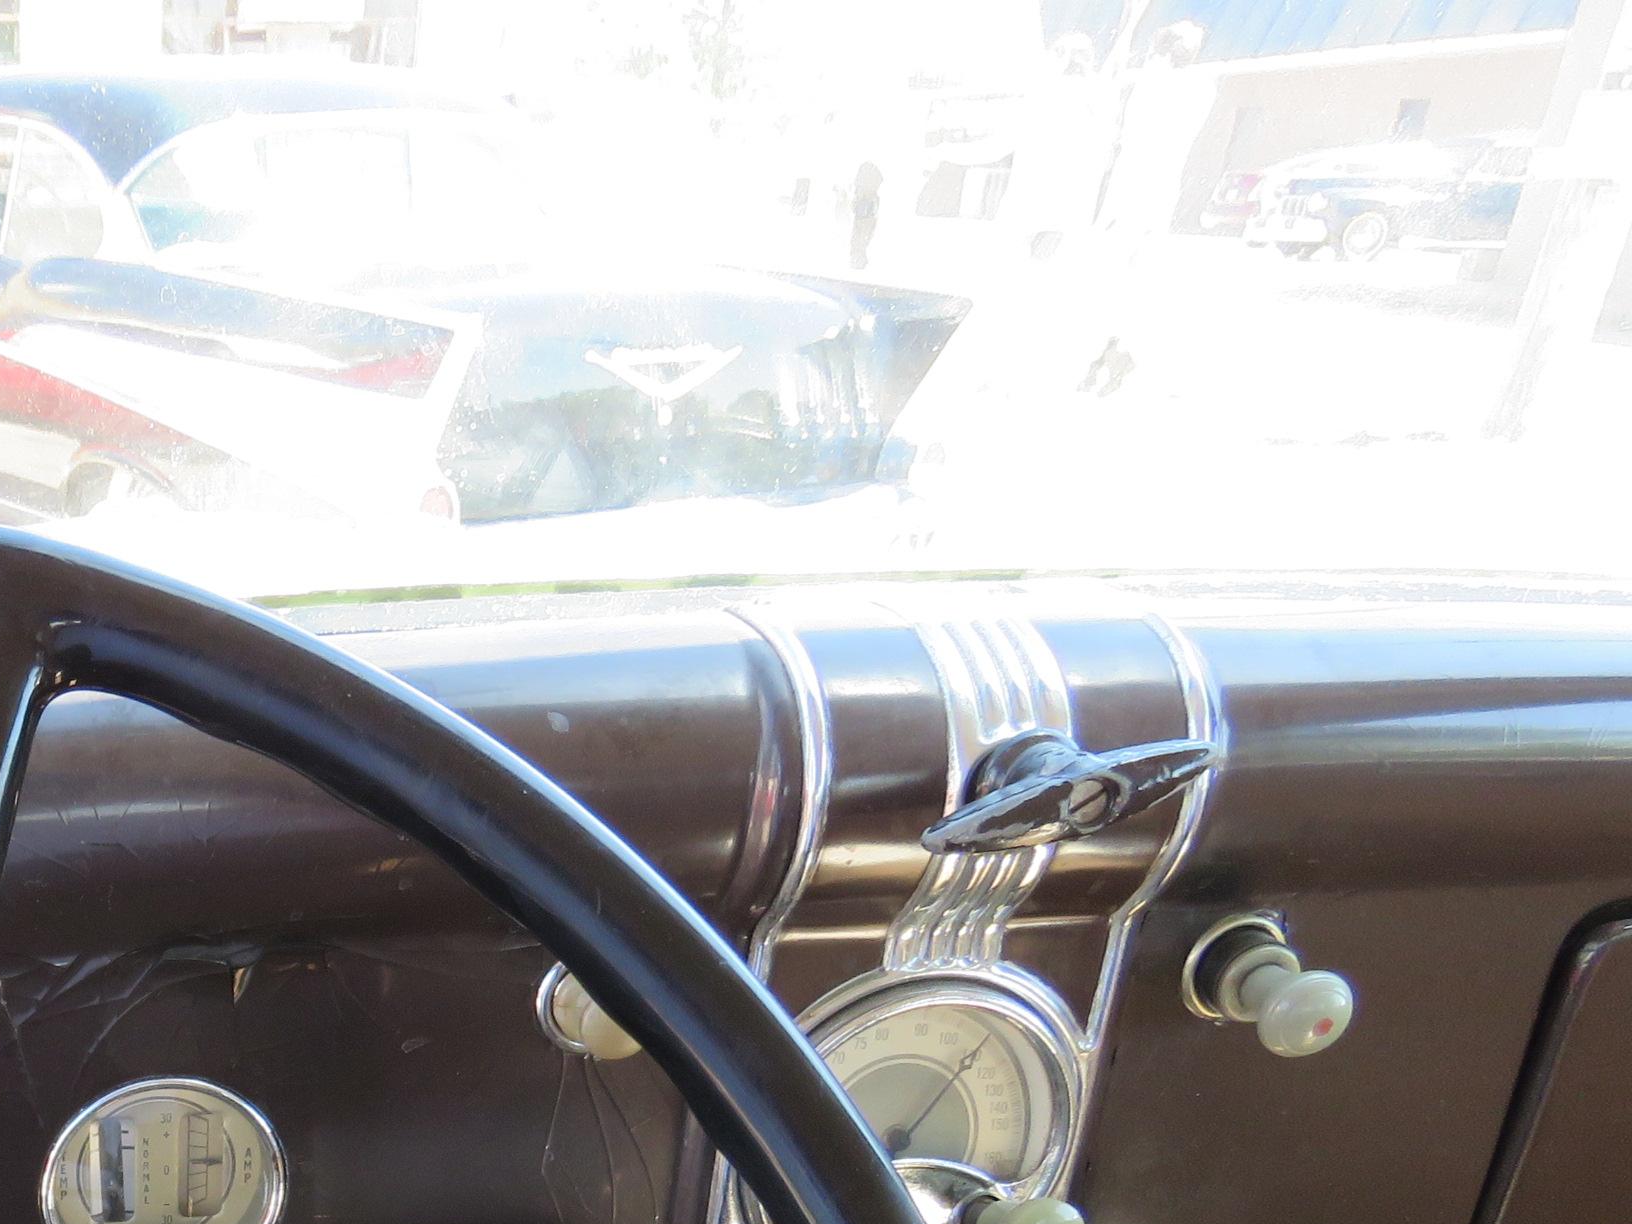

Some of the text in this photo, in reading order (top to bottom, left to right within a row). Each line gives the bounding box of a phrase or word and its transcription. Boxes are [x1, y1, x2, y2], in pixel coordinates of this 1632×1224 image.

[875, 1028, 890, 1041] 80
[939, 1032, 960, 1045] 100
[855, 1037, 867, 1050] 75
[833, 1052, 845, 1065] 70
[977, 1067, 996, 1080] 120
[985, 1084, 1004, 1097] 130
[990, 1101, 1009, 1114] 140
[161, 1112, 172, 1125] 30
[991, 1117, 1009, 1131] 150
[142, 1137, 150, 1205] NORMAL
[244, 1147, 253, 1183] AMP
